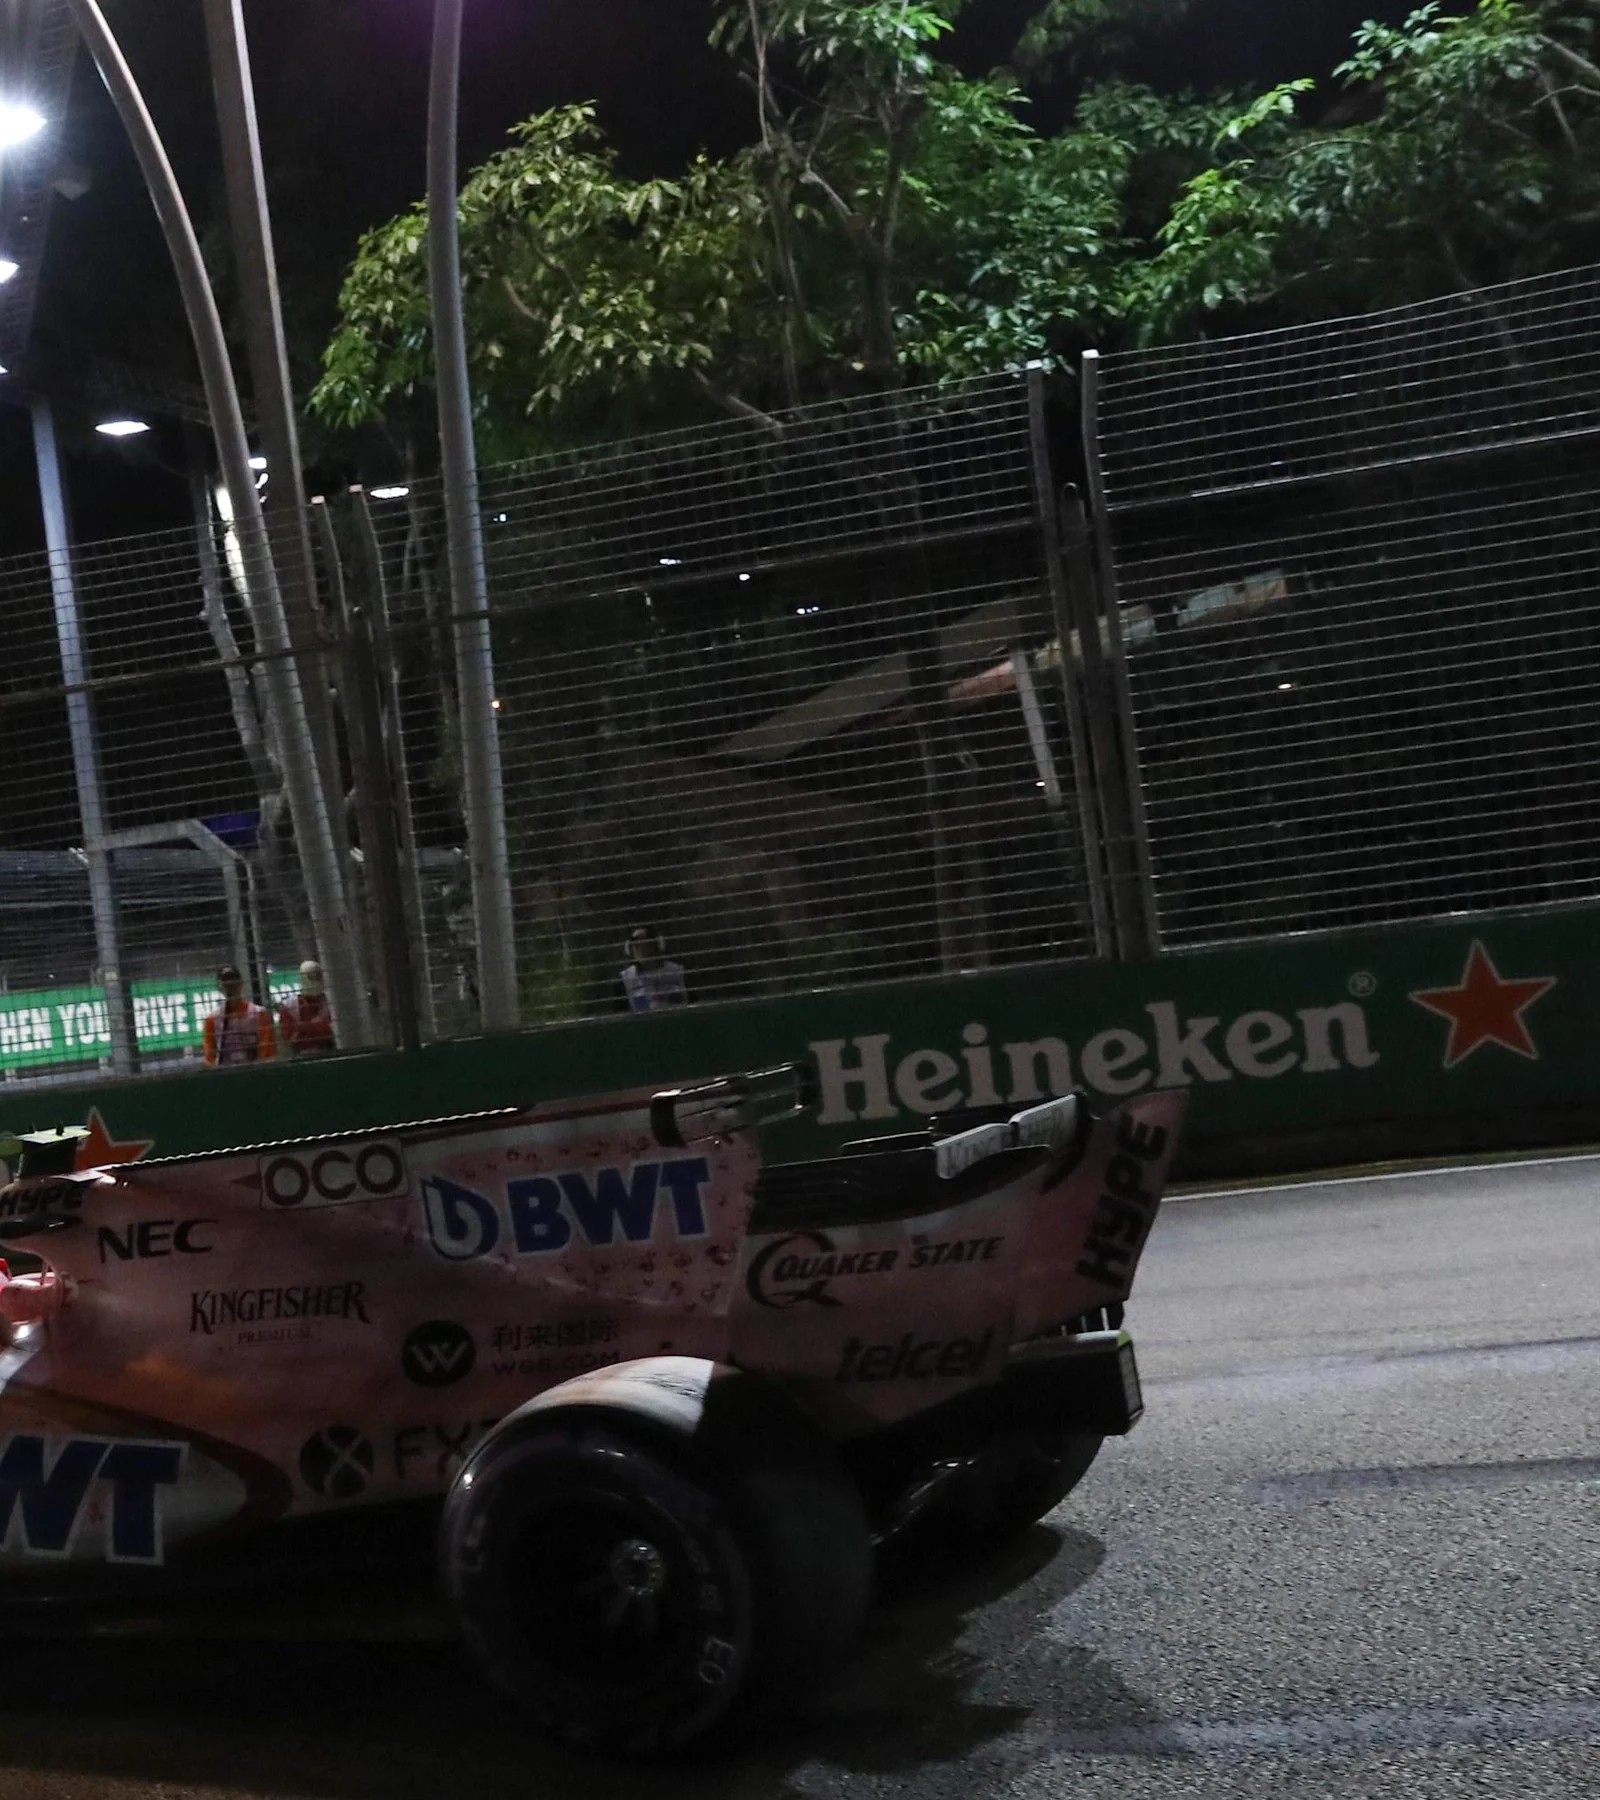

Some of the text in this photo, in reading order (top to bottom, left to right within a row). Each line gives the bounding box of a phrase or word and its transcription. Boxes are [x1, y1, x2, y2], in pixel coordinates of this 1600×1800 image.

[57, 999, 111, 1048] YOU
[135, 992, 190, 1038] RIVE
[809, 1000, 1380, 1125] Heineken
[264, 1143, 402, 1207] OCO
[1075, 1112, 1167, 1290] HYPE
[506, 1156, 710, 1253] BWT
[98, 1218, 220, 1263] NEC
[772, 1236, 1005, 1281] QUAKER STATE
[189, 1280, 371, 1335] KINGFISHER
[834, 1327, 993, 1385] telcel
